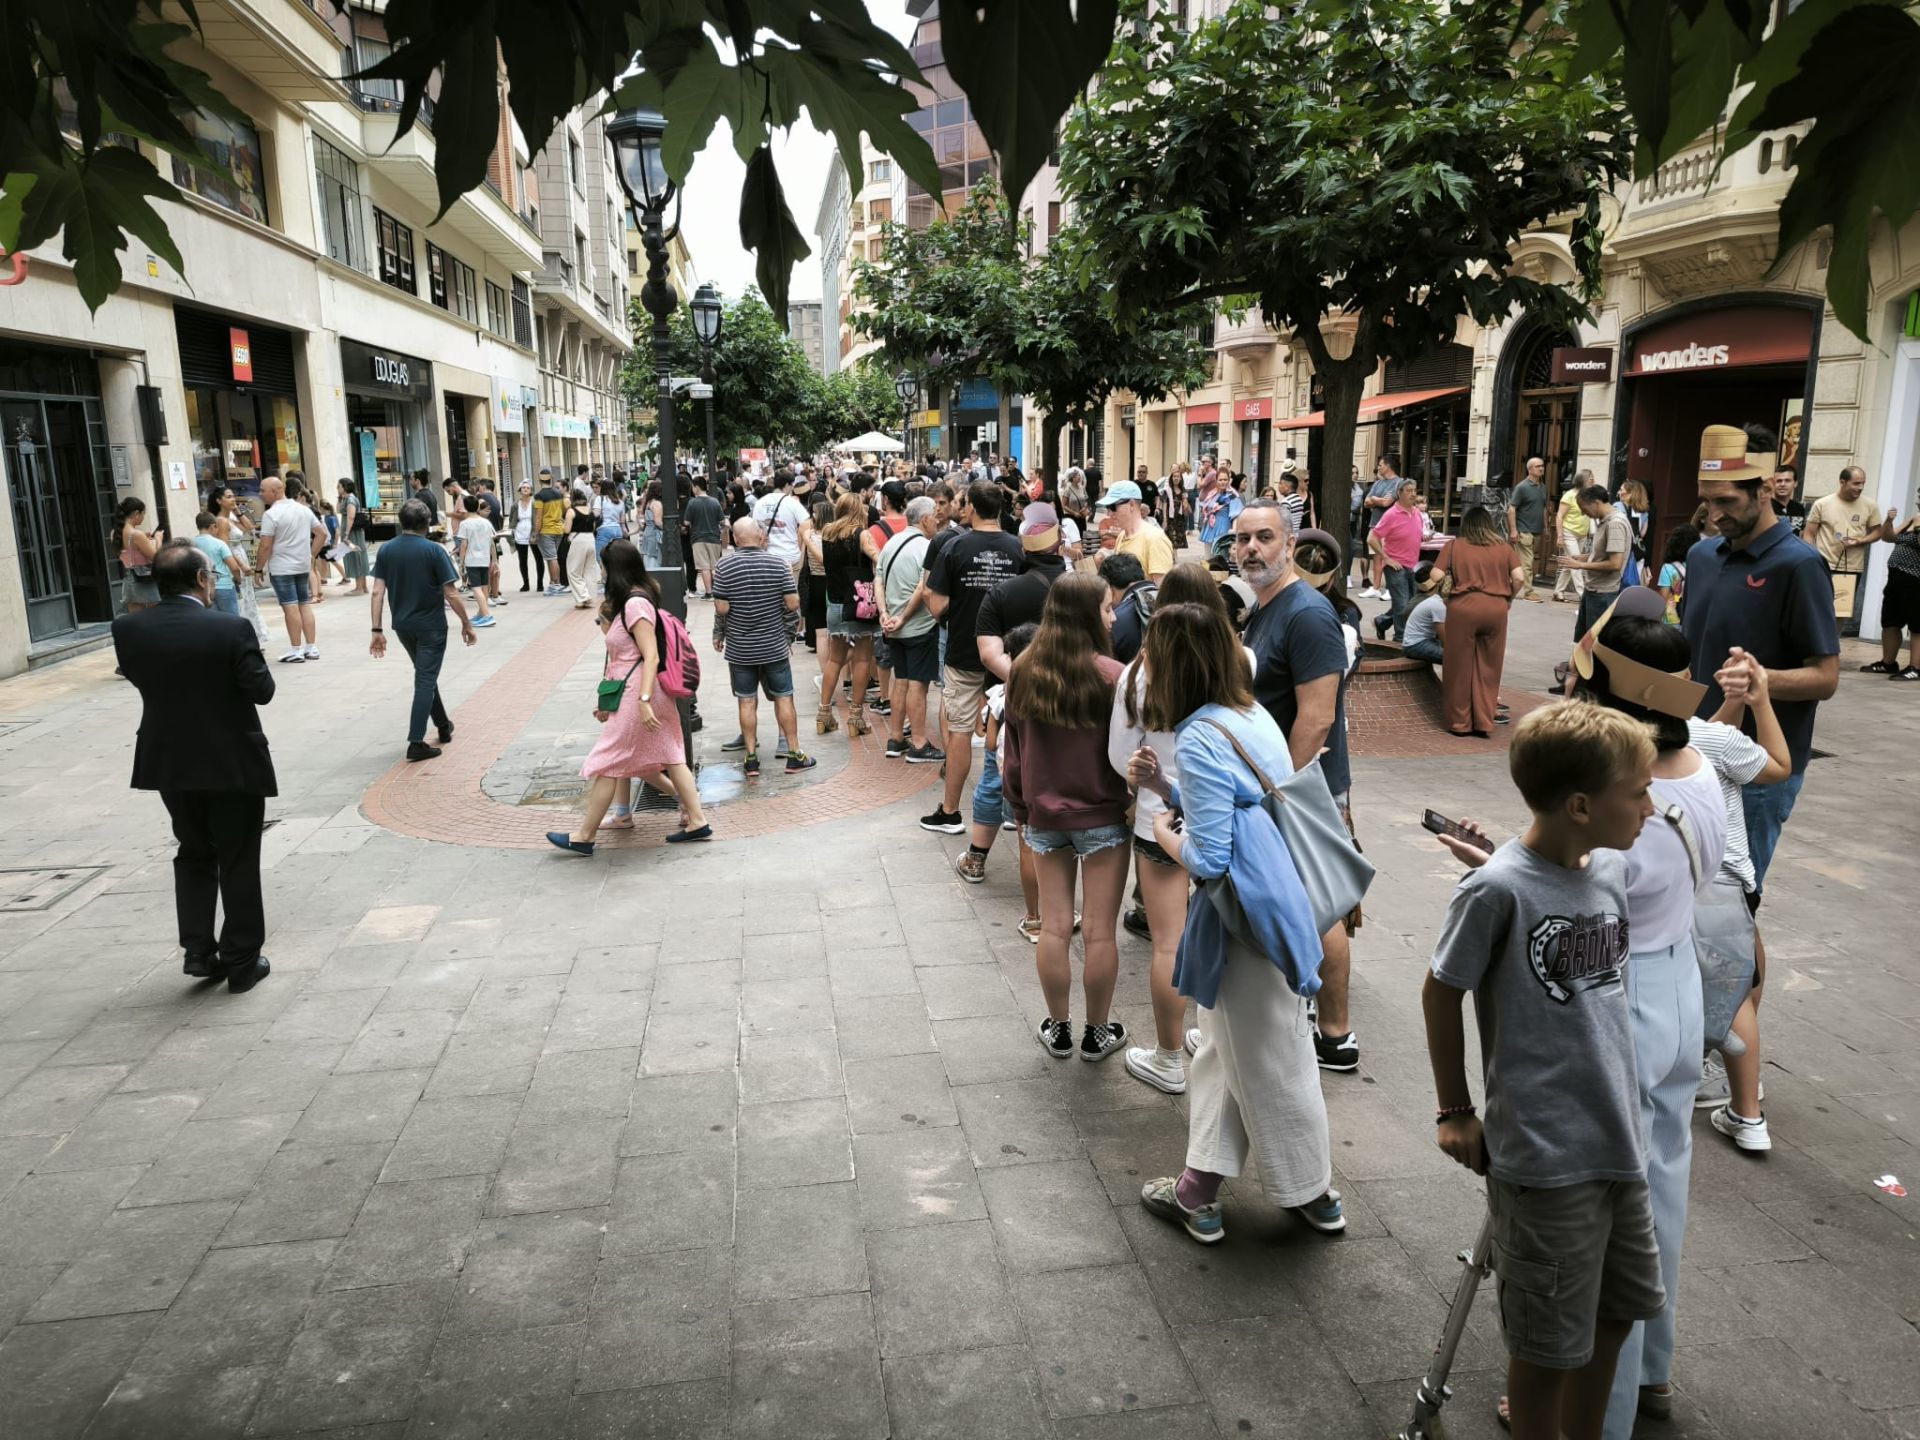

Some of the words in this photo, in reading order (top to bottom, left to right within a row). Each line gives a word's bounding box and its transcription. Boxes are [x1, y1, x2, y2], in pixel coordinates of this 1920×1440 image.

[234, 346, 249, 364] LEGO
[1641, 342, 1729, 372] wonders
[375, 356, 409, 386] DOUGLAS
[1565, 360, 1607, 370] wonders
[1245, 403, 1260, 416] GAES
